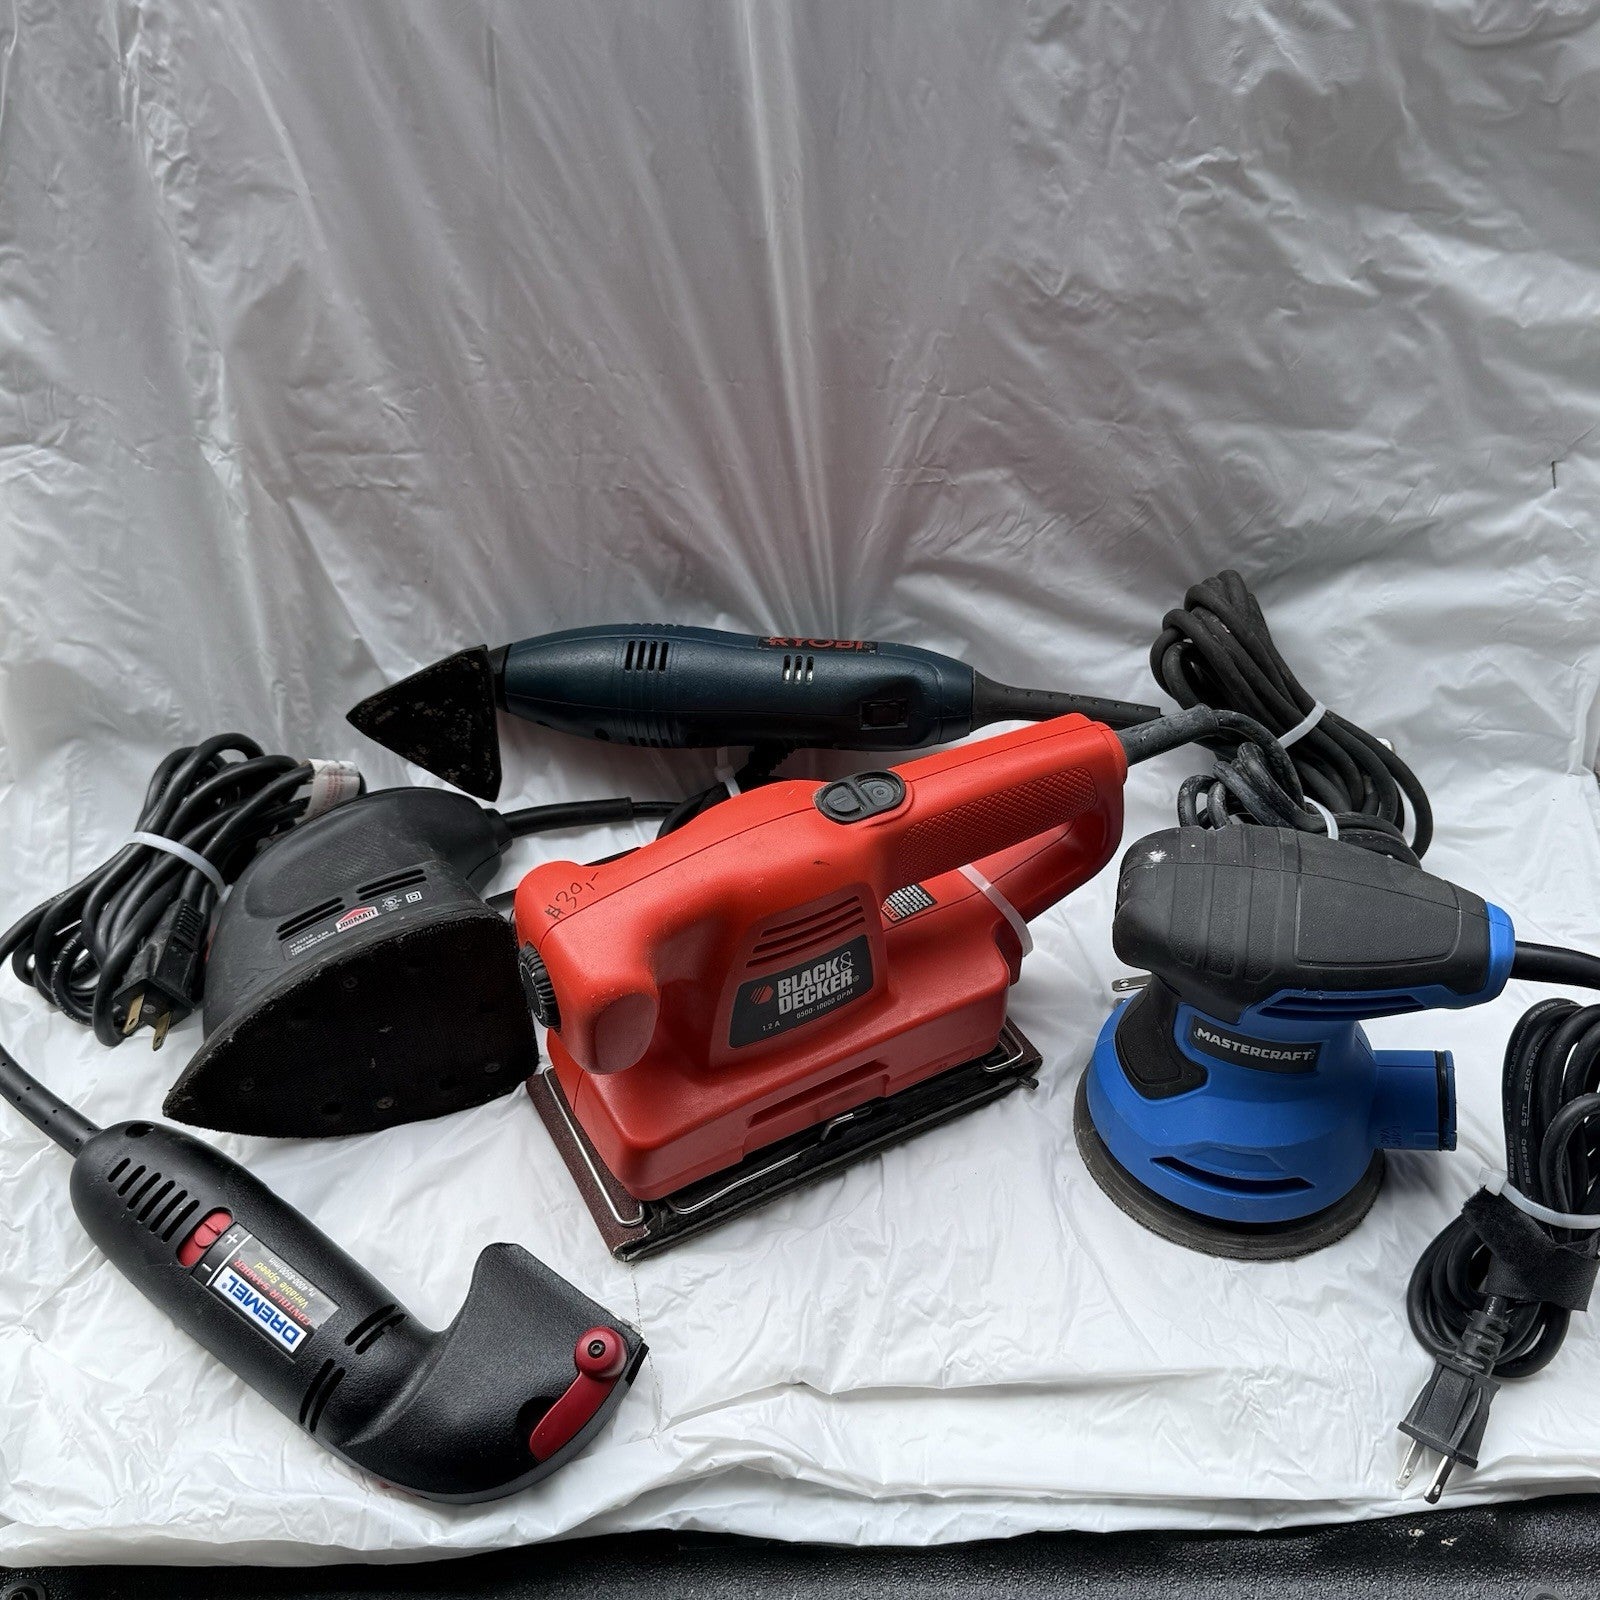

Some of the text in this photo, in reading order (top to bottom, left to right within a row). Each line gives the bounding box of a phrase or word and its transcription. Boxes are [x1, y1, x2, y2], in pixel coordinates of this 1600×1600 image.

[768, 636, 863, 649] RYOBI
[778, 956, 840, 997] BLACK
[779, 968, 854, 1015] DECKER
[1196, 1027, 1312, 1061] MASTERCRAFT
[234, 1259, 312, 1326] CONTOUR SANDER
[253, 1262, 309, 1309] Variable Speed
[227, 1275, 301, 1345] DREMEL
